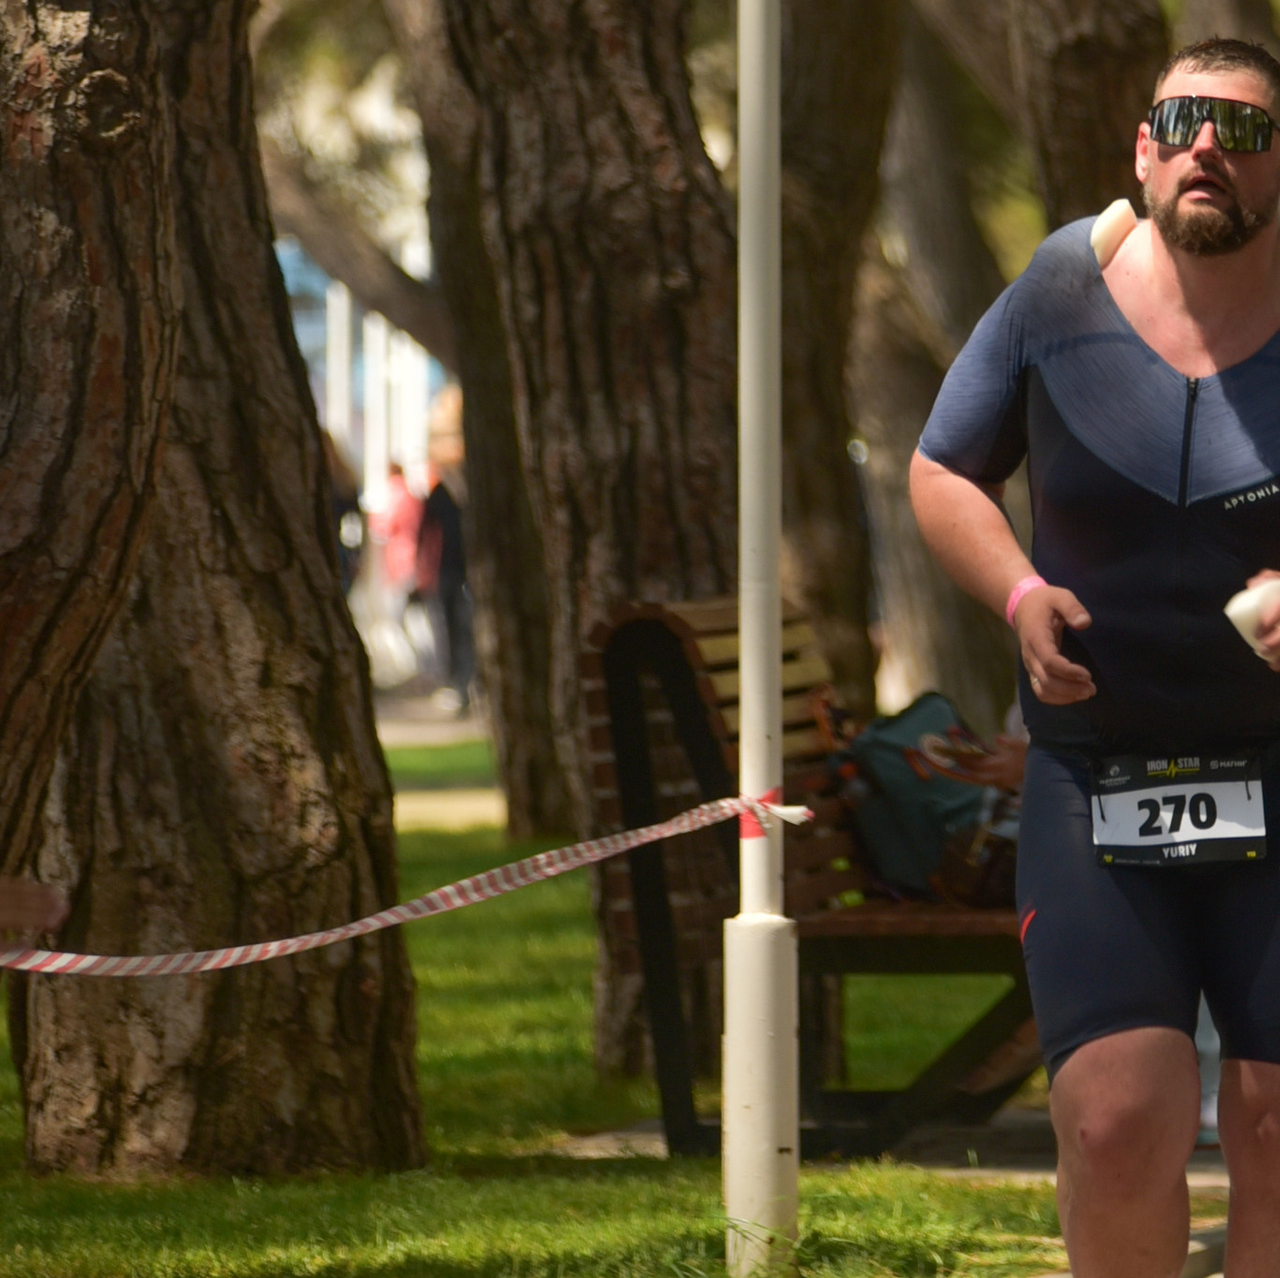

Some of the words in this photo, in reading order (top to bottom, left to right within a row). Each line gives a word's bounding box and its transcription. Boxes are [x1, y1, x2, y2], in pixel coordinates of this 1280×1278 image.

[1223, 484, 1280, 511] APTONIA
[1146, 759, 1168, 772] IRON
[1176, 756, 1200, 769] STAR
[1137, 792, 1217, 837] 270
[1162, 843, 1197, 859] YURIY
